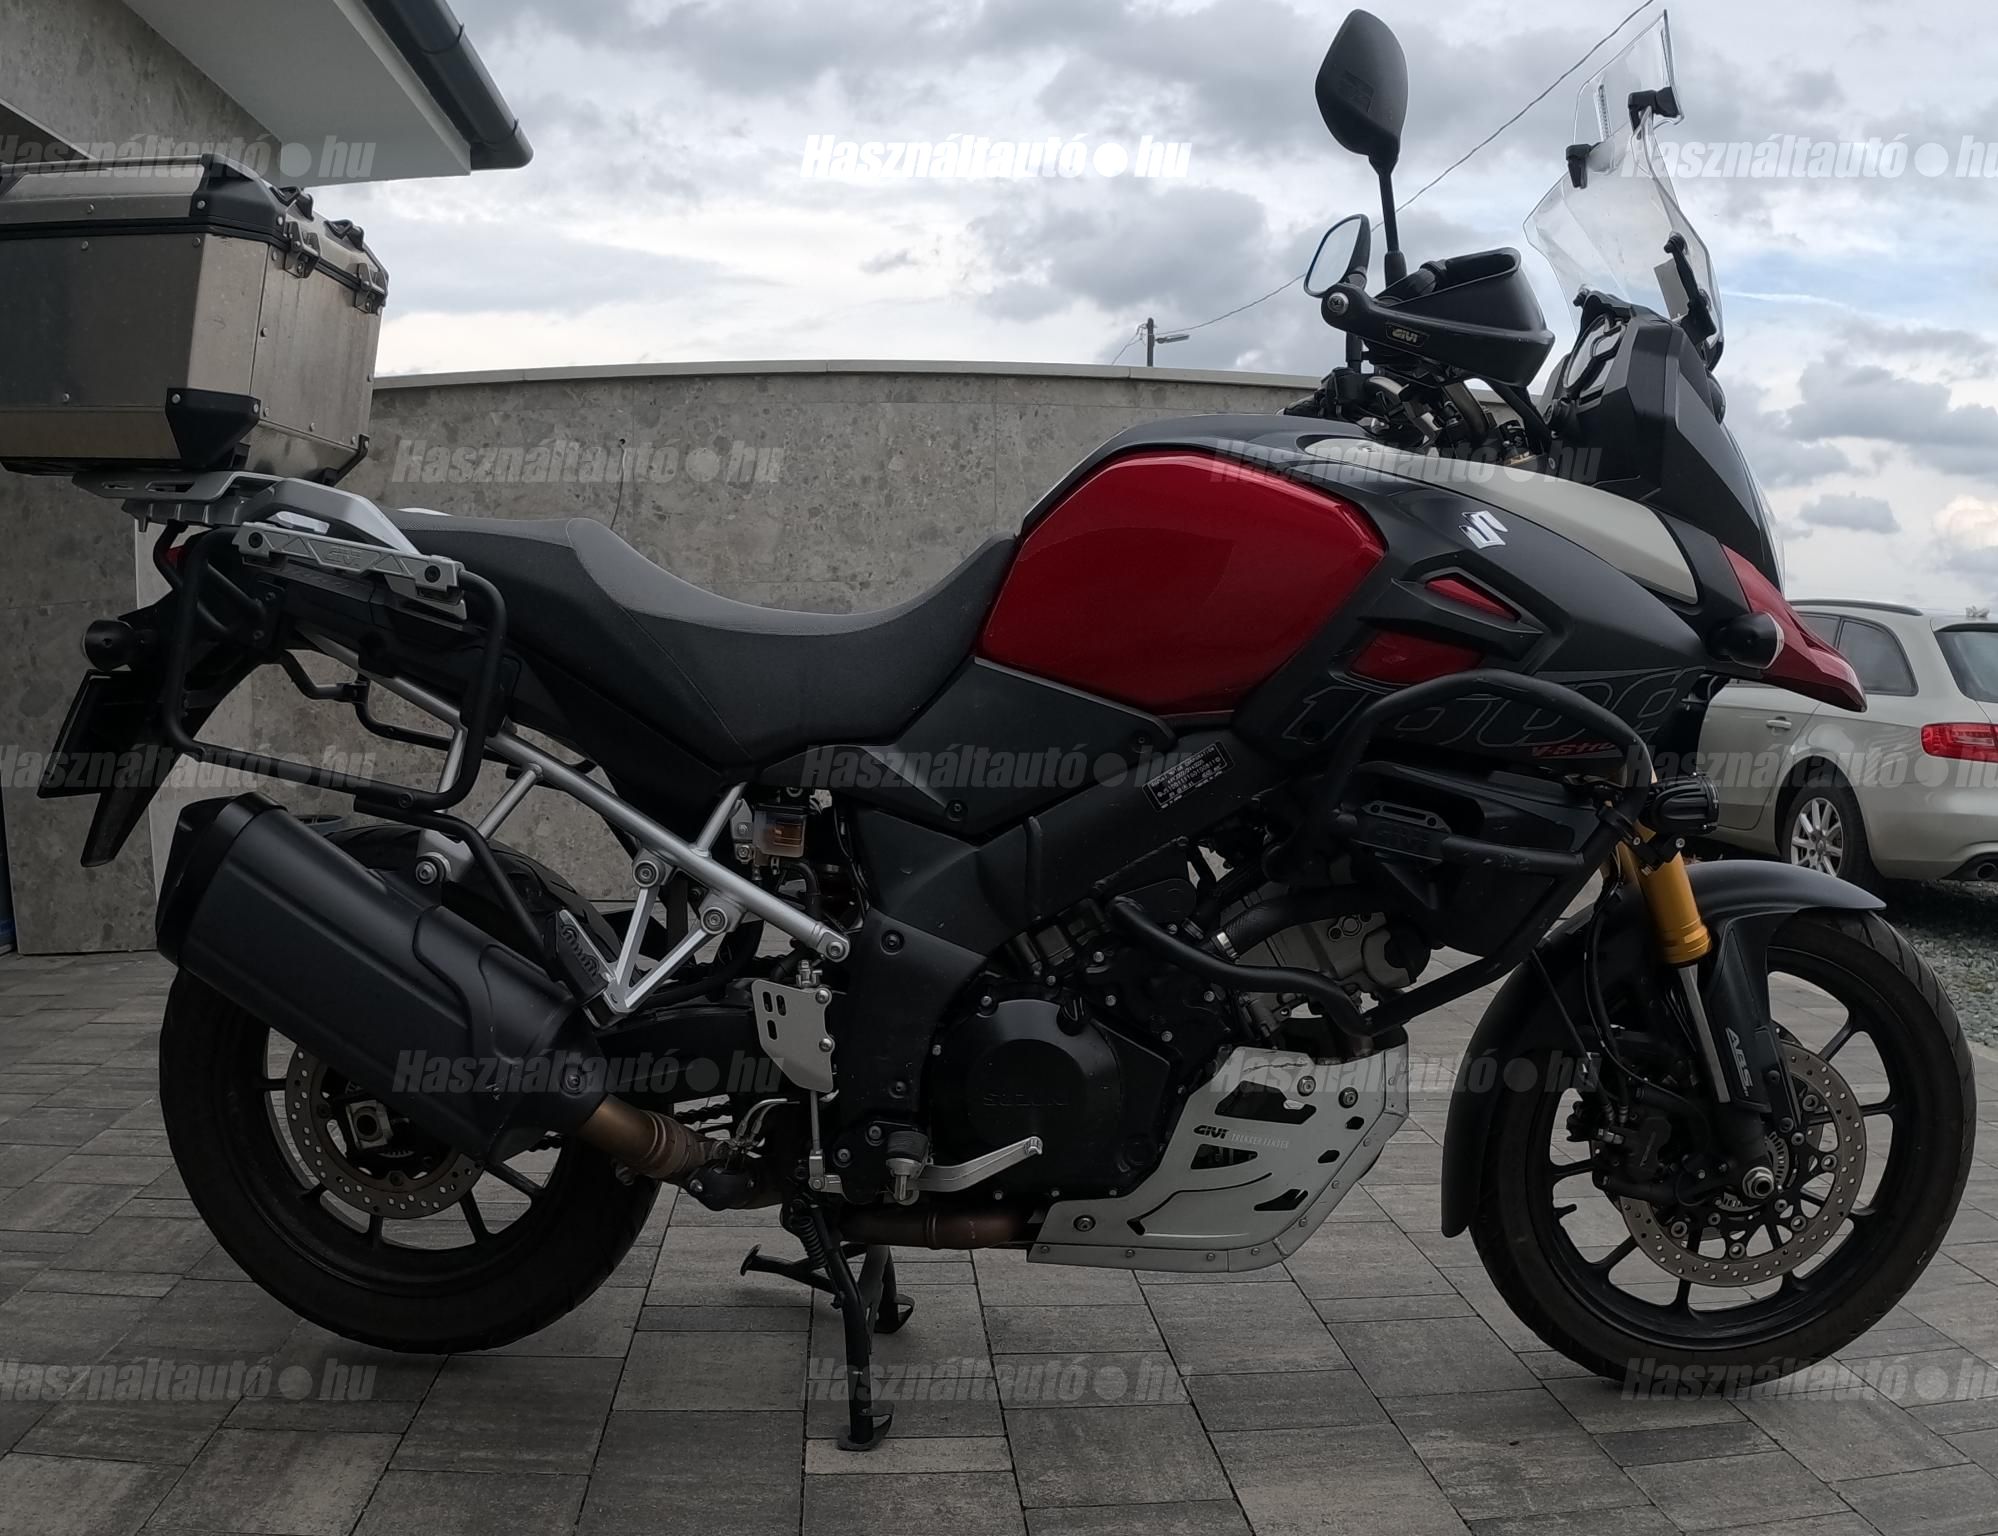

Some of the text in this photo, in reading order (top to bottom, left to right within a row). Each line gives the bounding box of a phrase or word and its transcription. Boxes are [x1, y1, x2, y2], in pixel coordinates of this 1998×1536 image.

[1392, 328, 1419, 344] GIVI
[1726, 1027, 1753, 1096] ABS
[1193, 1124, 1229, 1139] GIVI
